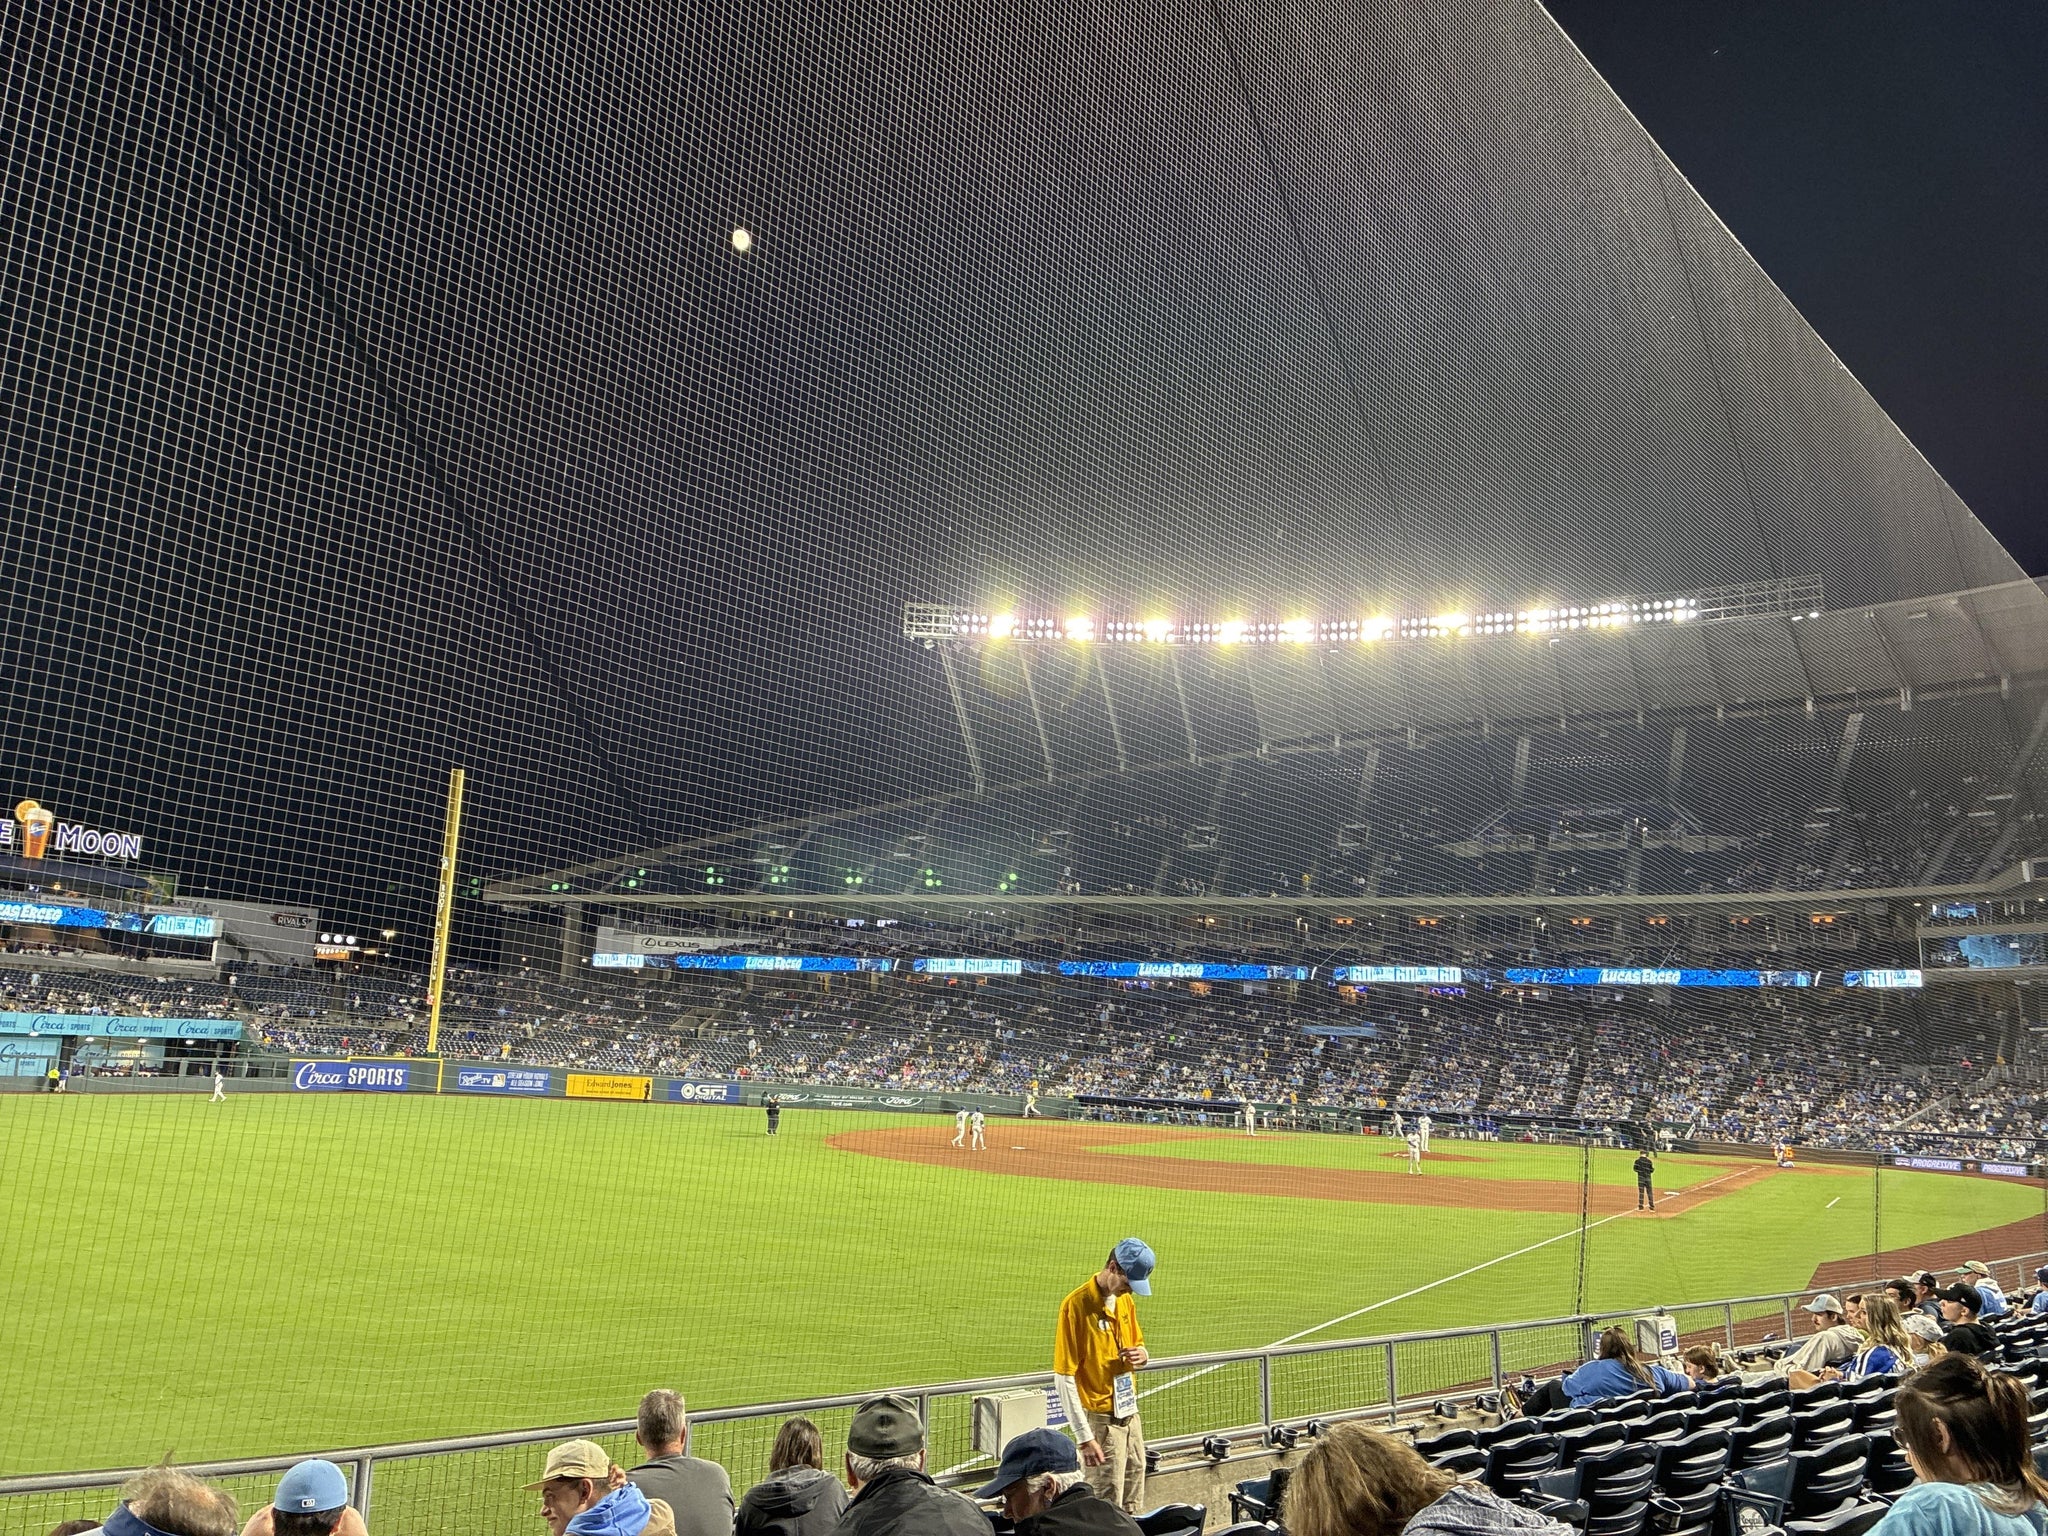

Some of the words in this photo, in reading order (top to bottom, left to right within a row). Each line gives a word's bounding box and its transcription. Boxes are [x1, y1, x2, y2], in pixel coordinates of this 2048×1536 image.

[55, 822, 141, 859] MOON
[277, 915, 307, 926] RIVALS
[657, 940, 701, 948] LEXUS
[745, 956, 775, 970] LUCAS
[1138, 962, 1171, 977] LUCAS
[1171, 962, 1204, 978] ERCEG
[1600, 968, 1641, 984] LUCAS
[1641, 968, 1681, 985] ERCEG
[32, 1015, 65, 1032] Circa
[70, 1023, 91, 1032] SPORTS
[106, 1017, 138, 1034] Circa
[143, 1025, 163, 1033] SPORTS
[177, 1021, 209, 1036] Circa
[214, 1027, 234, 1036] SPORTS
[295, 1062, 342, 1089] Circa
[347, 1067, 404, 1086] SPORTS
[611, 1080, 632, 1088] Jones
[886, 1096, 913, 1105] Ford
[1912, 1158, 1961, 1170] PROGRESSIVE
[1982, 1163, 2026, 1176] PROGRESSIVE
